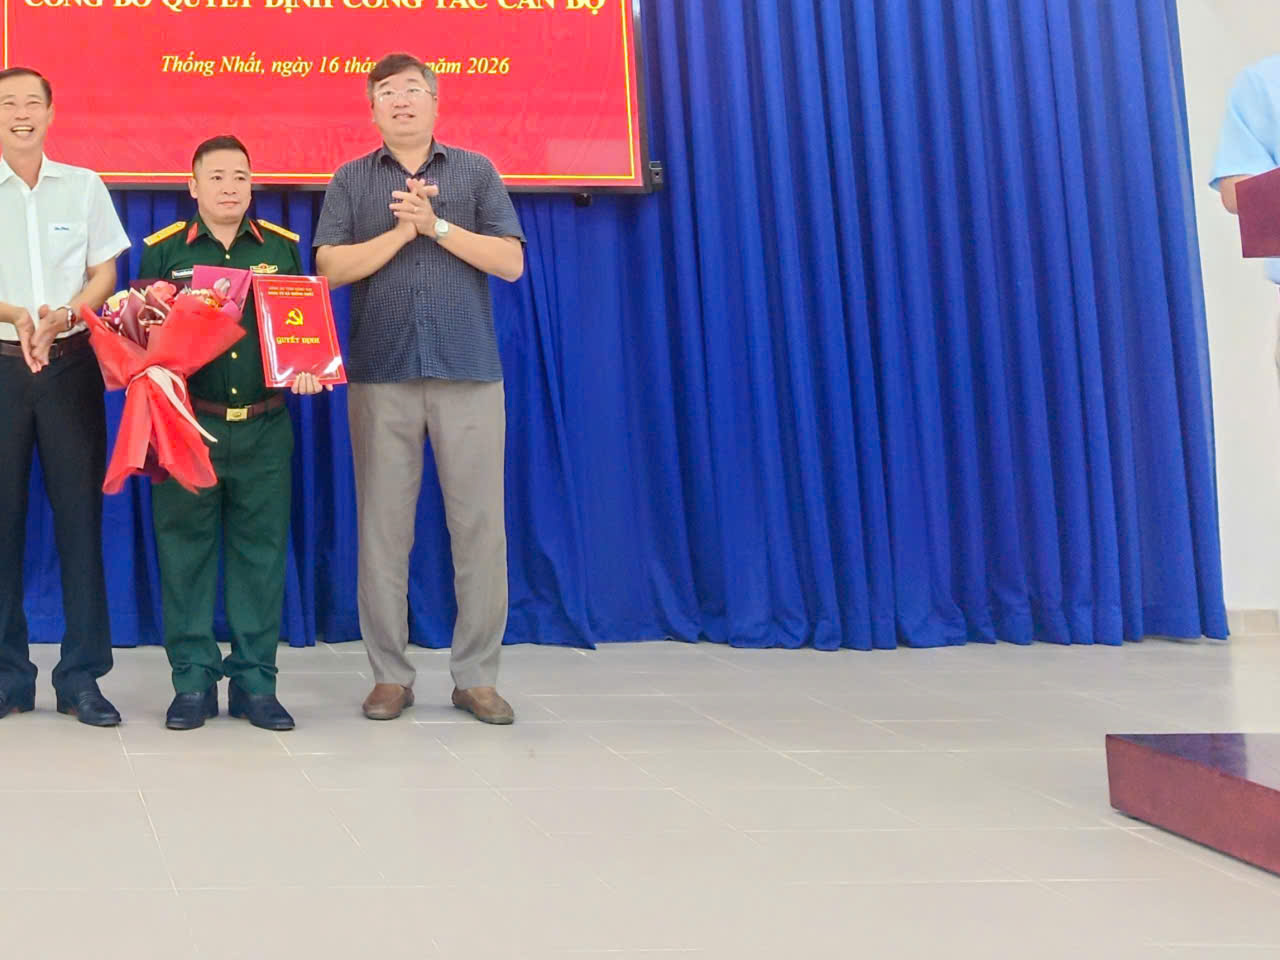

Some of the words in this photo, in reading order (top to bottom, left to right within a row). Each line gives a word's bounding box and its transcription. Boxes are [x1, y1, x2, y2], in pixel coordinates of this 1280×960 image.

[162, 51, 216, 77] Thống
[220, 51, 265, 74] Nhất,
[271, 56, 313, 77] ngày
[319, 56, 340, 73] 16
[344, 56, 376, 74] thá
[467, 57, 510, 75] 2026
